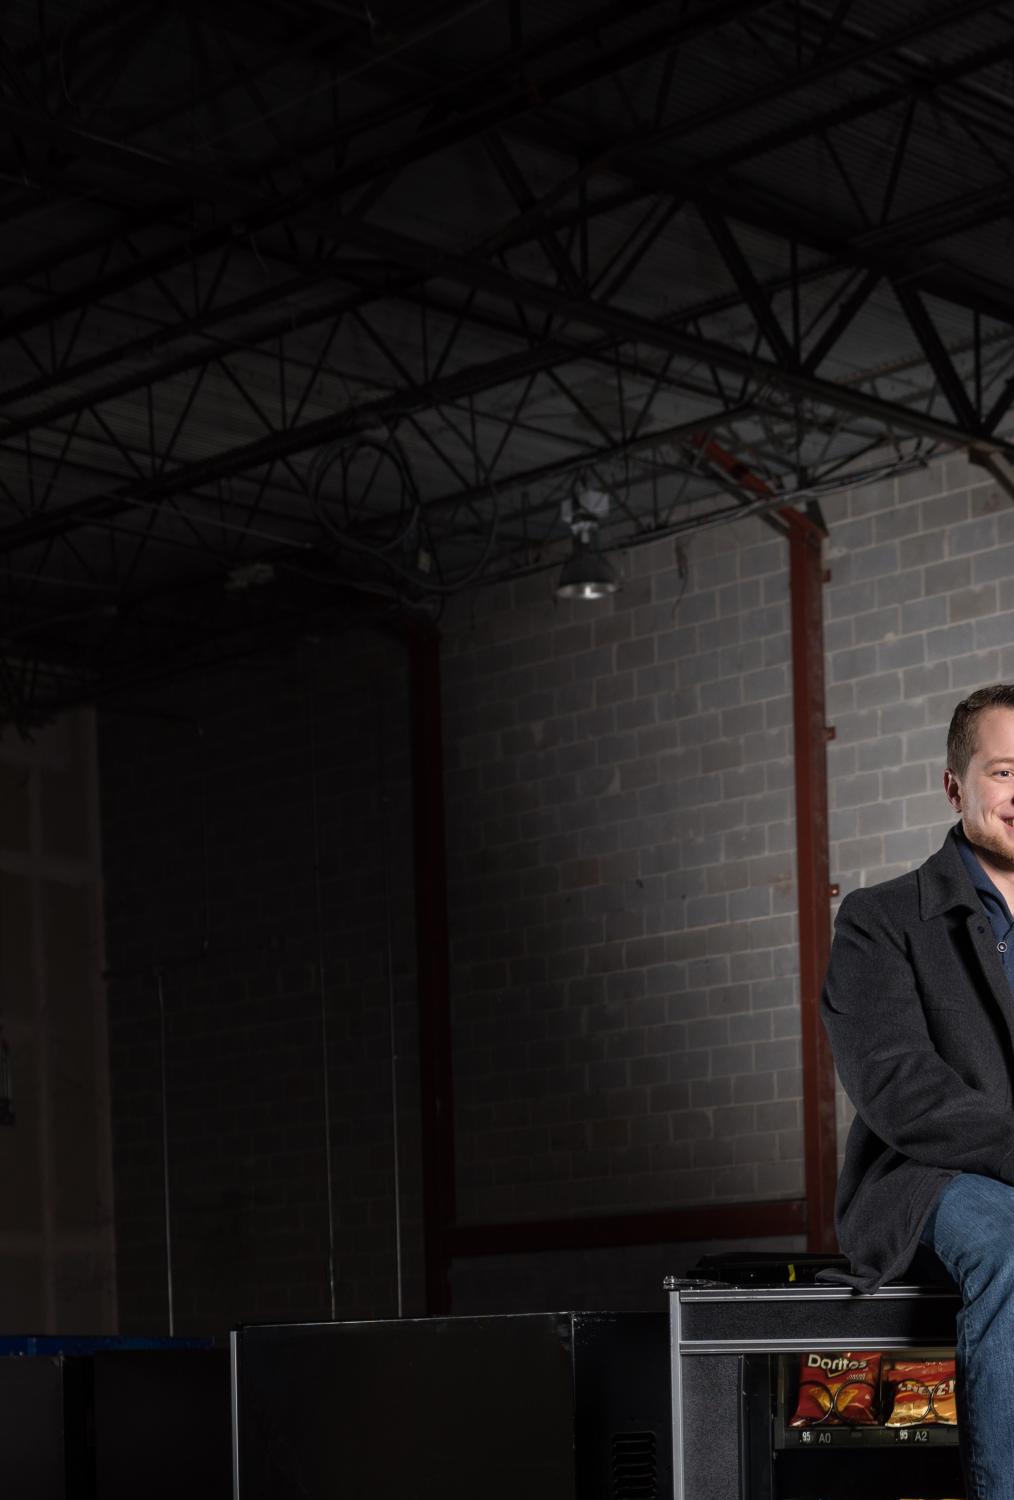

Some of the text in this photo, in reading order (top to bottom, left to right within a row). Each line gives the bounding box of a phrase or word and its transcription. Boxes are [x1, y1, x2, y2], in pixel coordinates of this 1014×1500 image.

[808, 1354, 868, 1372] Doritos
[801, 1431, 832, 1444] .95 A0
[896, 1429, 929, 1442] .95 A2
